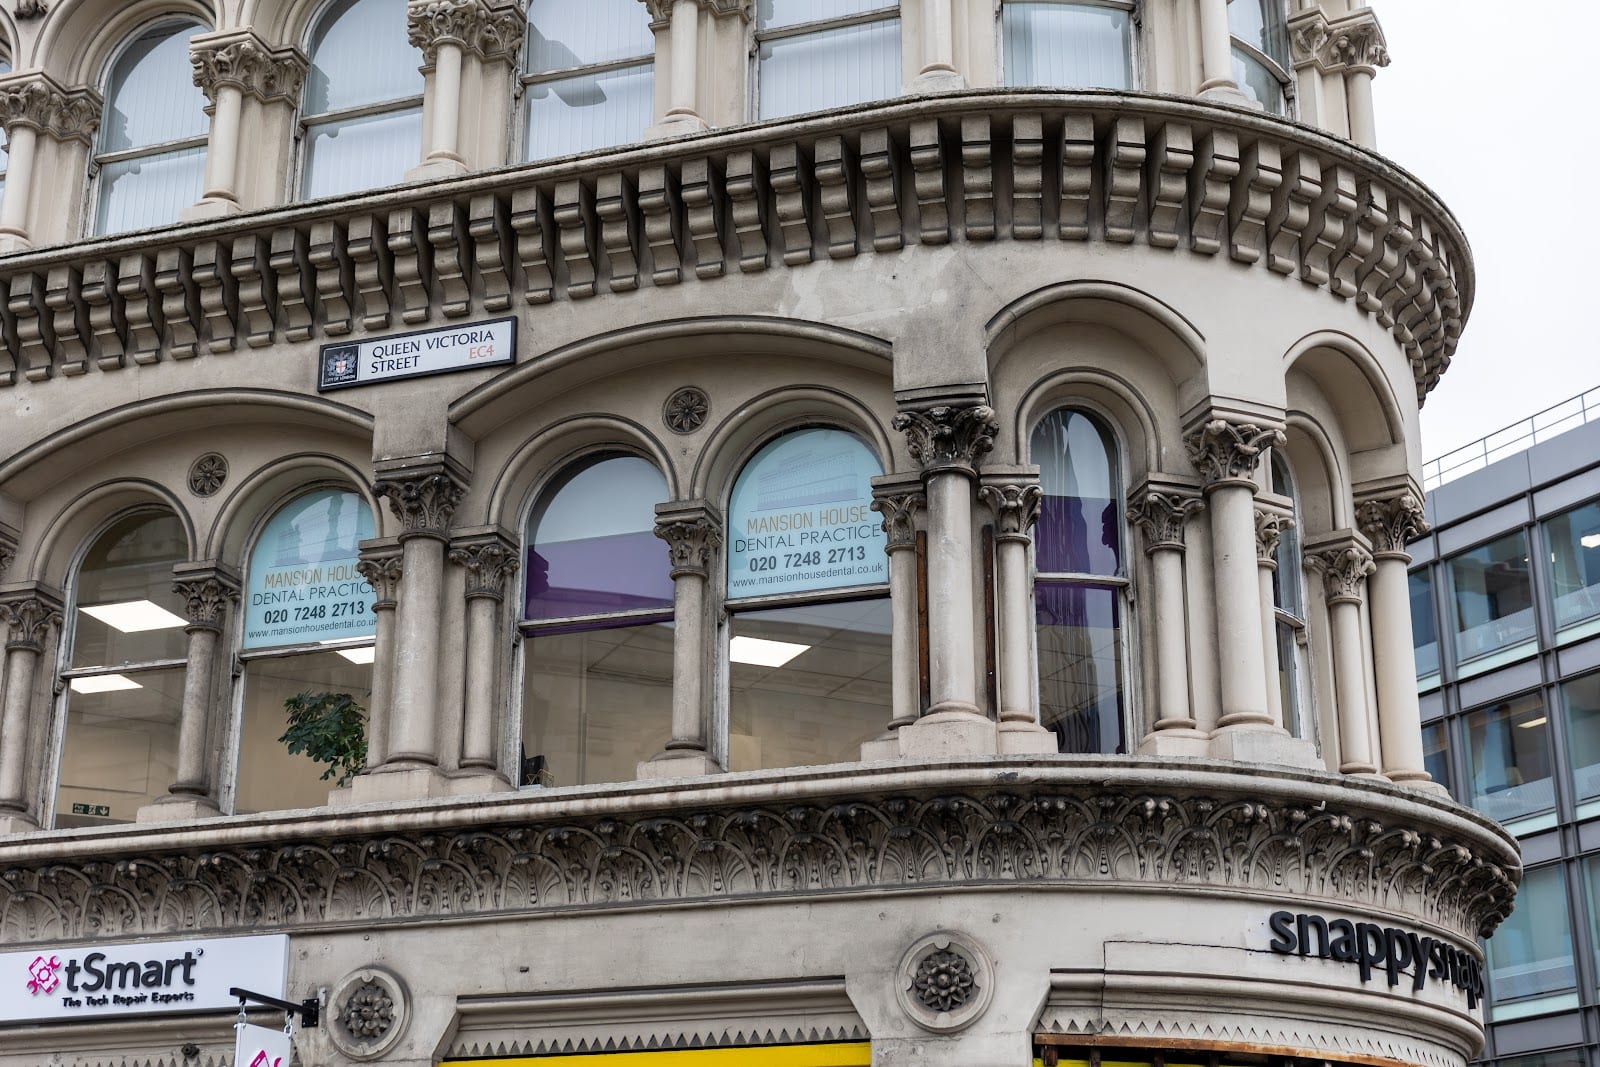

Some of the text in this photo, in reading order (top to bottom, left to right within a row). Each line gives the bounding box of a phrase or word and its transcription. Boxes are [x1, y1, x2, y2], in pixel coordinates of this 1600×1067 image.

[372, 330, 494, 359] QUEEN VICTORIA
[469, 345, 495, 359] EC4
[371, 355, 421, 374] STREET
[747, 505, 868, 535] MANSION HOUSE
[735, 523, 881, 553] DENTAL PRACTICE
[750, 545, 865, 572] 020 7248 2713
[264, 563, 362, 589] MANSION HOUS
[733, 562, 883, 587] www.mansionhousedental.co.uk
[252, 589, 304, 606] DENTAL
[264, 600, 365, 624] 020 7248 2713
[65, 952, 197, 992] tSmart
[62, 992, 194, 1007] The Tech Repair Experts
